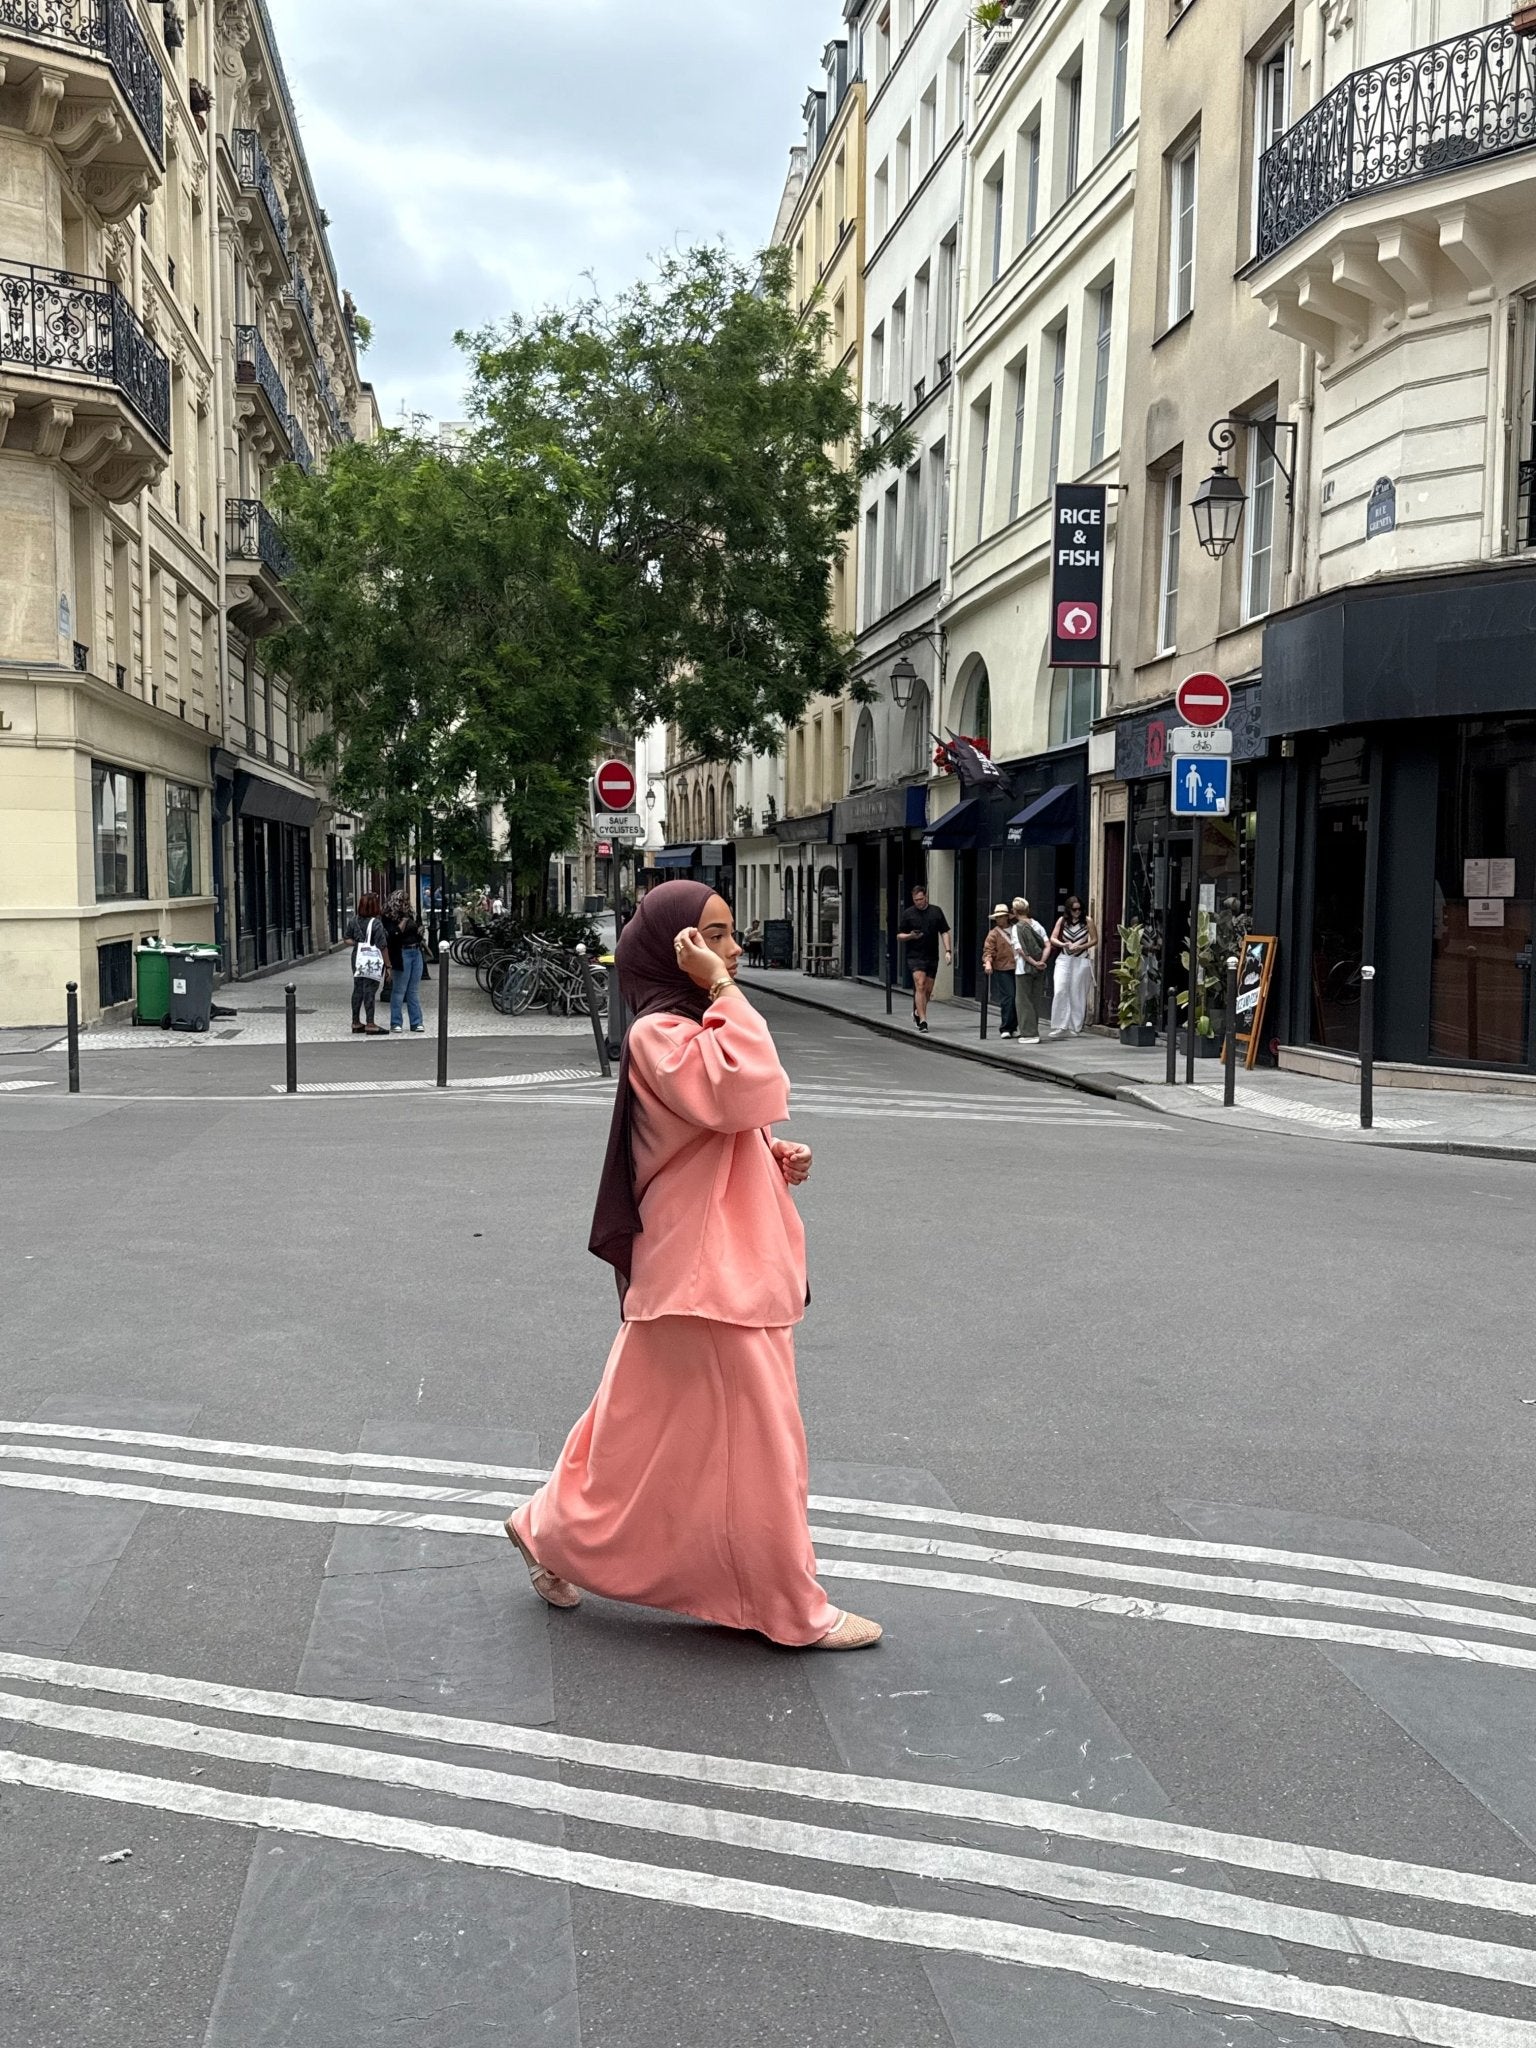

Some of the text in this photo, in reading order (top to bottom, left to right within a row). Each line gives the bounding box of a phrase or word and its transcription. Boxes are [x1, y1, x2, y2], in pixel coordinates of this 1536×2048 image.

[1059, 508, 1101, 525] RICE
[1375, 505, 1387, 517] RUE
[1072, 529, 1087, 544] &
[1058, 549, 1100, 567] FISH
[1190, 730, 1215, 738] SAUF
[609, 817, 629, 825] SAUF
[599, 826, 639, 834] CYCLISTES
